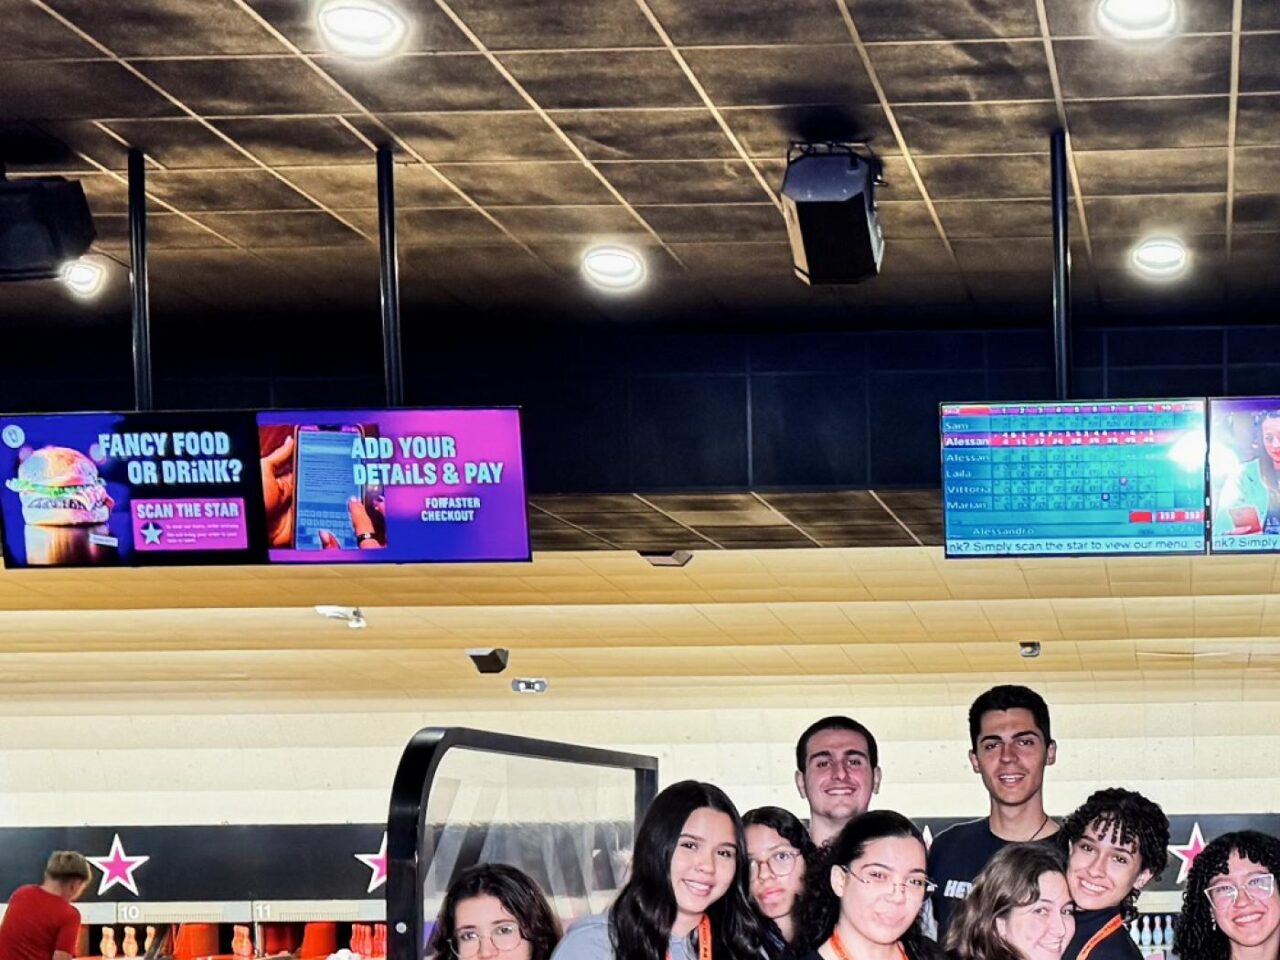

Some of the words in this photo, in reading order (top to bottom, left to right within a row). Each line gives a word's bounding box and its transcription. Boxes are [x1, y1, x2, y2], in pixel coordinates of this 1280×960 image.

[98, 432, 168, 457] FANCY
[173, 431, 230, 456] FOOD
[352, 436, 394, 459] ADD
[398, 436, 456, 459] YOUR
[128, 461, 158, 484] OR
[442, 462, 460, 485] &
[464, 462, 504, 483] PAY
[137, 503, 174, 518] SCAN
[176, 503, 202, 518] THE
[205, 502, 239, 517] STAR
[421, 509, 474, 521] CHECKOUT
[973, 541, 1012, 554] Simply
[1015, 542, 1043, 551] scan
[1046, 541, 1063, 550] the
[1067, 541, 1089, 550] star
[1091, 541, 1102, 550] to
[1106, 540, 1132, 549] view
[1135, 540, 1153, 549] our
[1238, 536, 1278, 548] Simply
[121, 905, 140, 920] 10
[256, 904, 271, 919] 11
